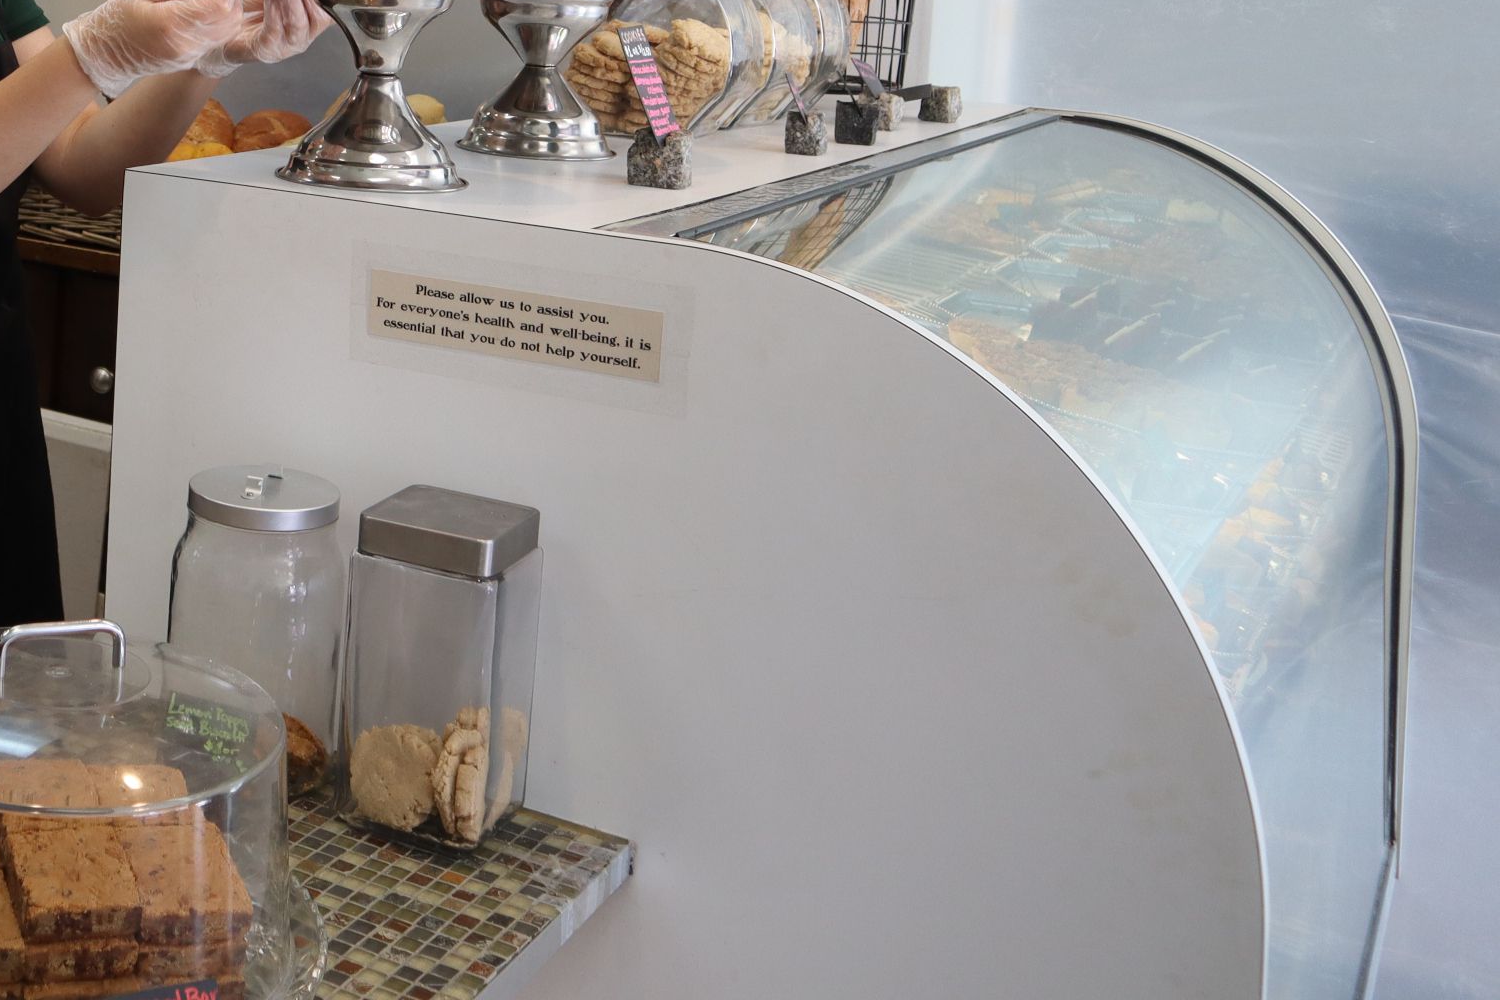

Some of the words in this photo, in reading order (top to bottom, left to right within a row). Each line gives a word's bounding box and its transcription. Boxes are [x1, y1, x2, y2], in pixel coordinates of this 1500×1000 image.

[376, 296, 396, 310] For
[400, 303, 470, 322] everyone's
[475, 312, 515, 329] health
[520, 320, 544, 334] and
[625, 336, 634, 349] it
[639, 339, 652, 351] is
[415, 284, 455, 301] Please
[459, 291, 494, 307] allow
[500, 299, 515, 310] us
[520, 301, 532, 313] to
[536, 303, 574, 319] assist
[579, 310, 610, 326] you.
[383, 318, 436, 335] essential
[440, 326, 465, 340] that
[470, 333, 495, 346] you
[500, 336, 516, 349] do
[520, 341, 541, 353] not
[545, 343, 575, 360] help
[579, 350, 641, 370] yourself.
